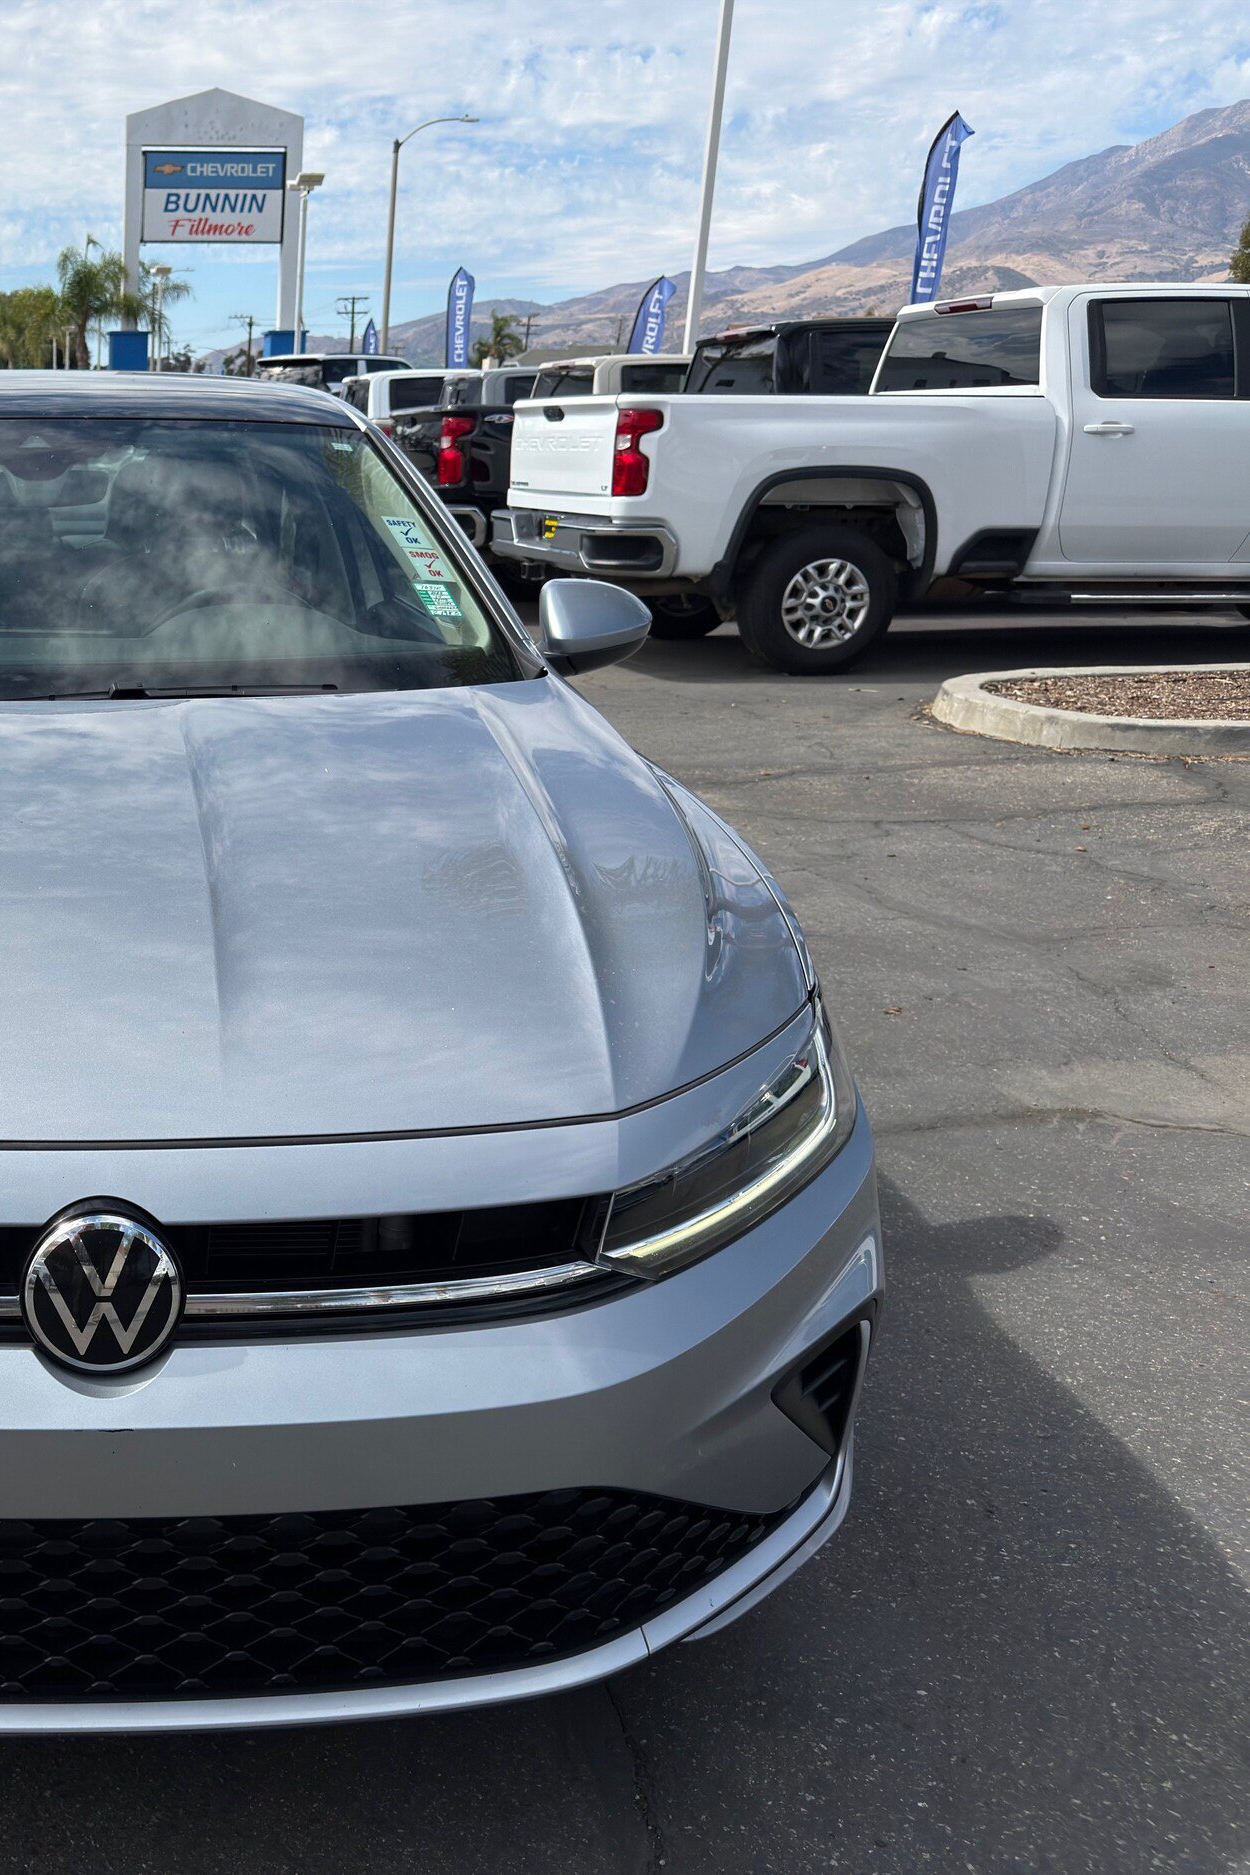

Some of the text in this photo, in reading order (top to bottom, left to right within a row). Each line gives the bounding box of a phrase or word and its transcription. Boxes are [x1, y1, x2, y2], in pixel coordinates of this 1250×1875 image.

[187, 163, 276, 177] CHEVROLET
[163, 192, 266, 214] BUNNIN
[168, 217, 256, 237] Fillmore
[454, 278, 468, 363] CHEVROLET
[514, 435, 605, 452] CHEVROLET
[386, 519, 417, 528] SAFETY
[405, 536, 421, 545] OK
[408, 551, 440, 560] SMOG
[428, 569, 444, 578] OK
